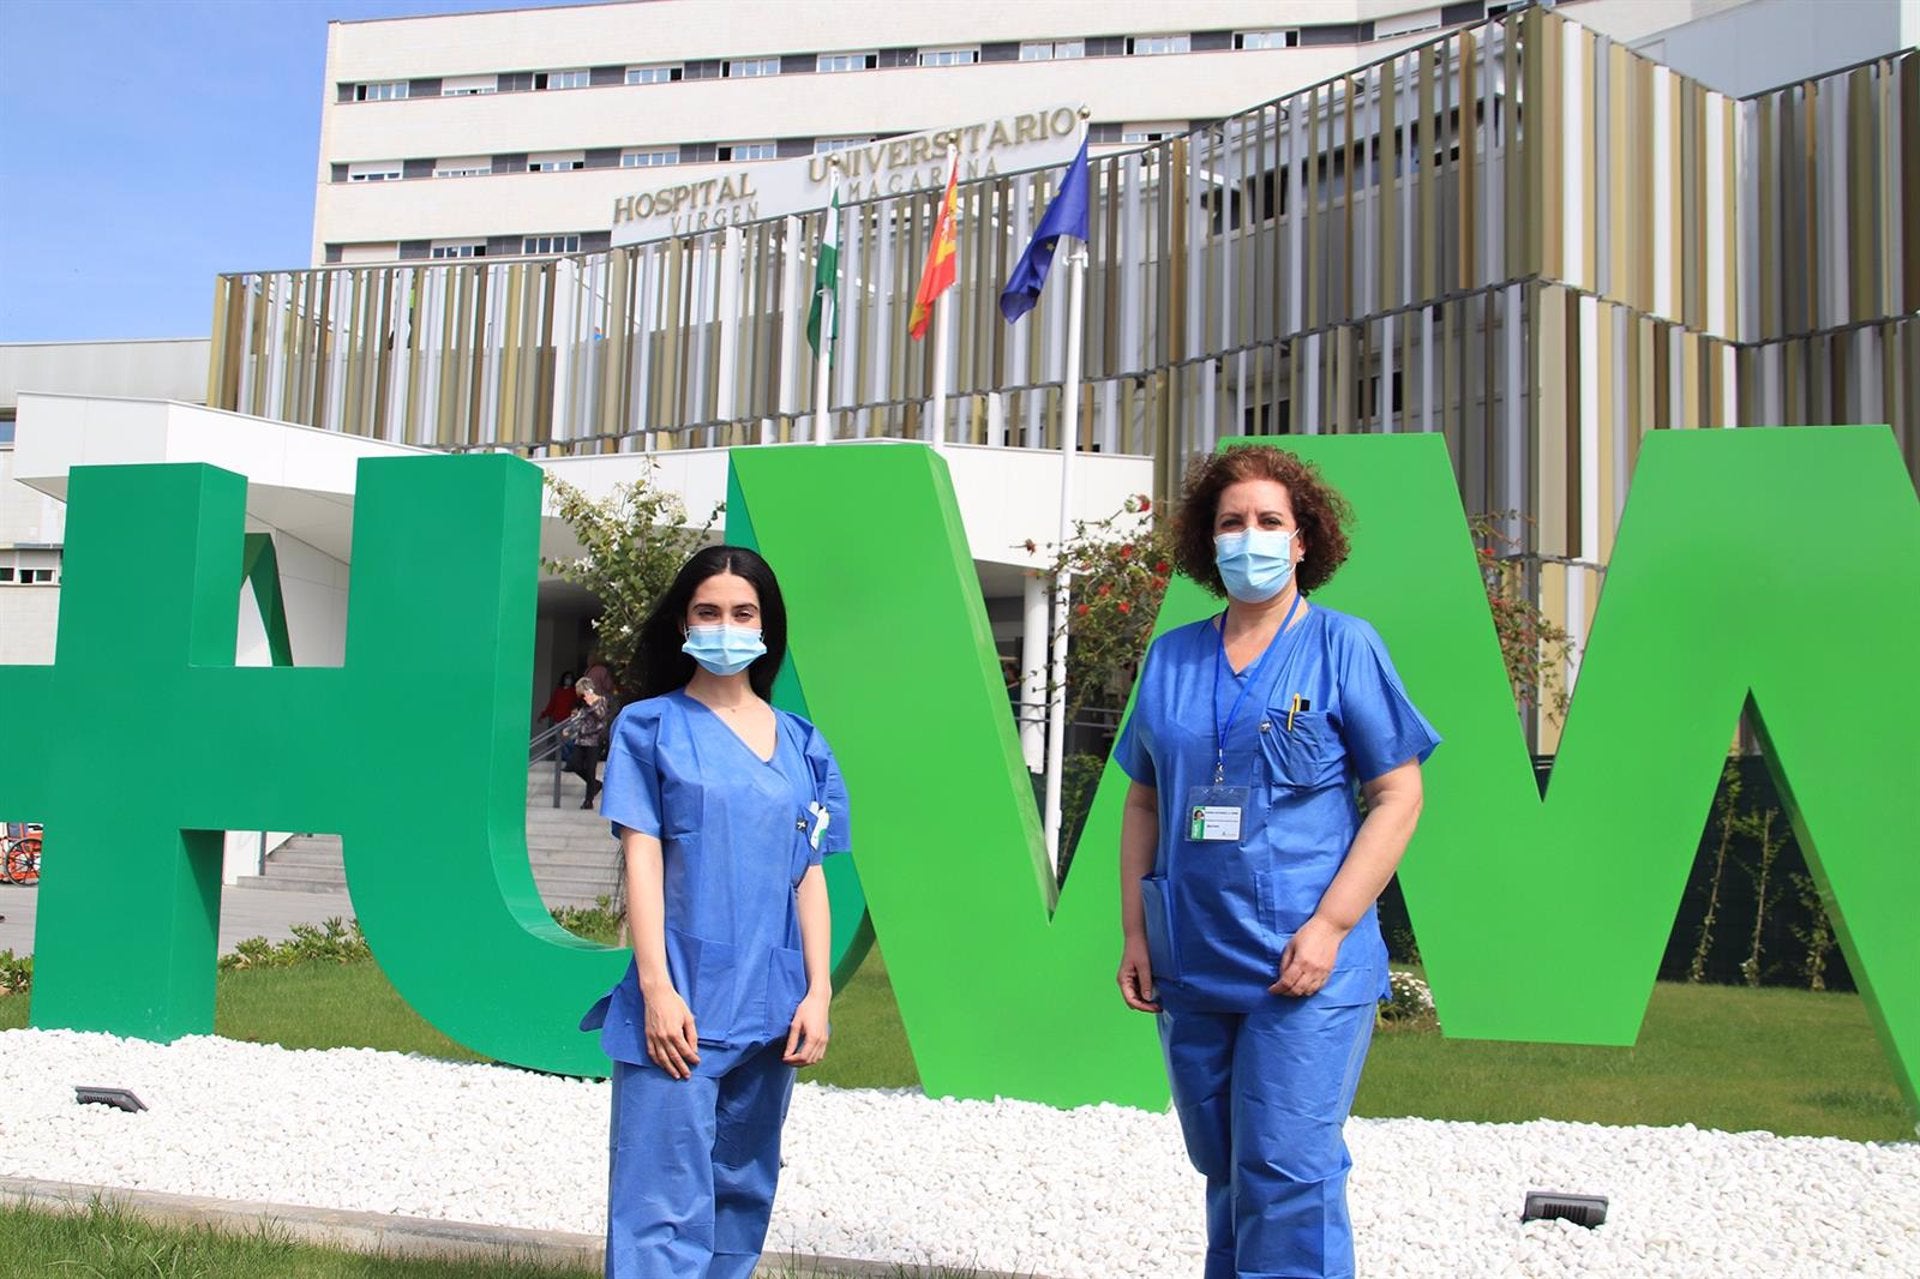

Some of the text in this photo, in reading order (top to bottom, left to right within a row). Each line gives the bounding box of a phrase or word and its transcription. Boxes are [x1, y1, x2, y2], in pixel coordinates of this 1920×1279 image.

[613, 107, 1076, 223] HOSPITAL UNIVERSITARIO
[671, 156, 997, 234] VIRGEN MACARNA
